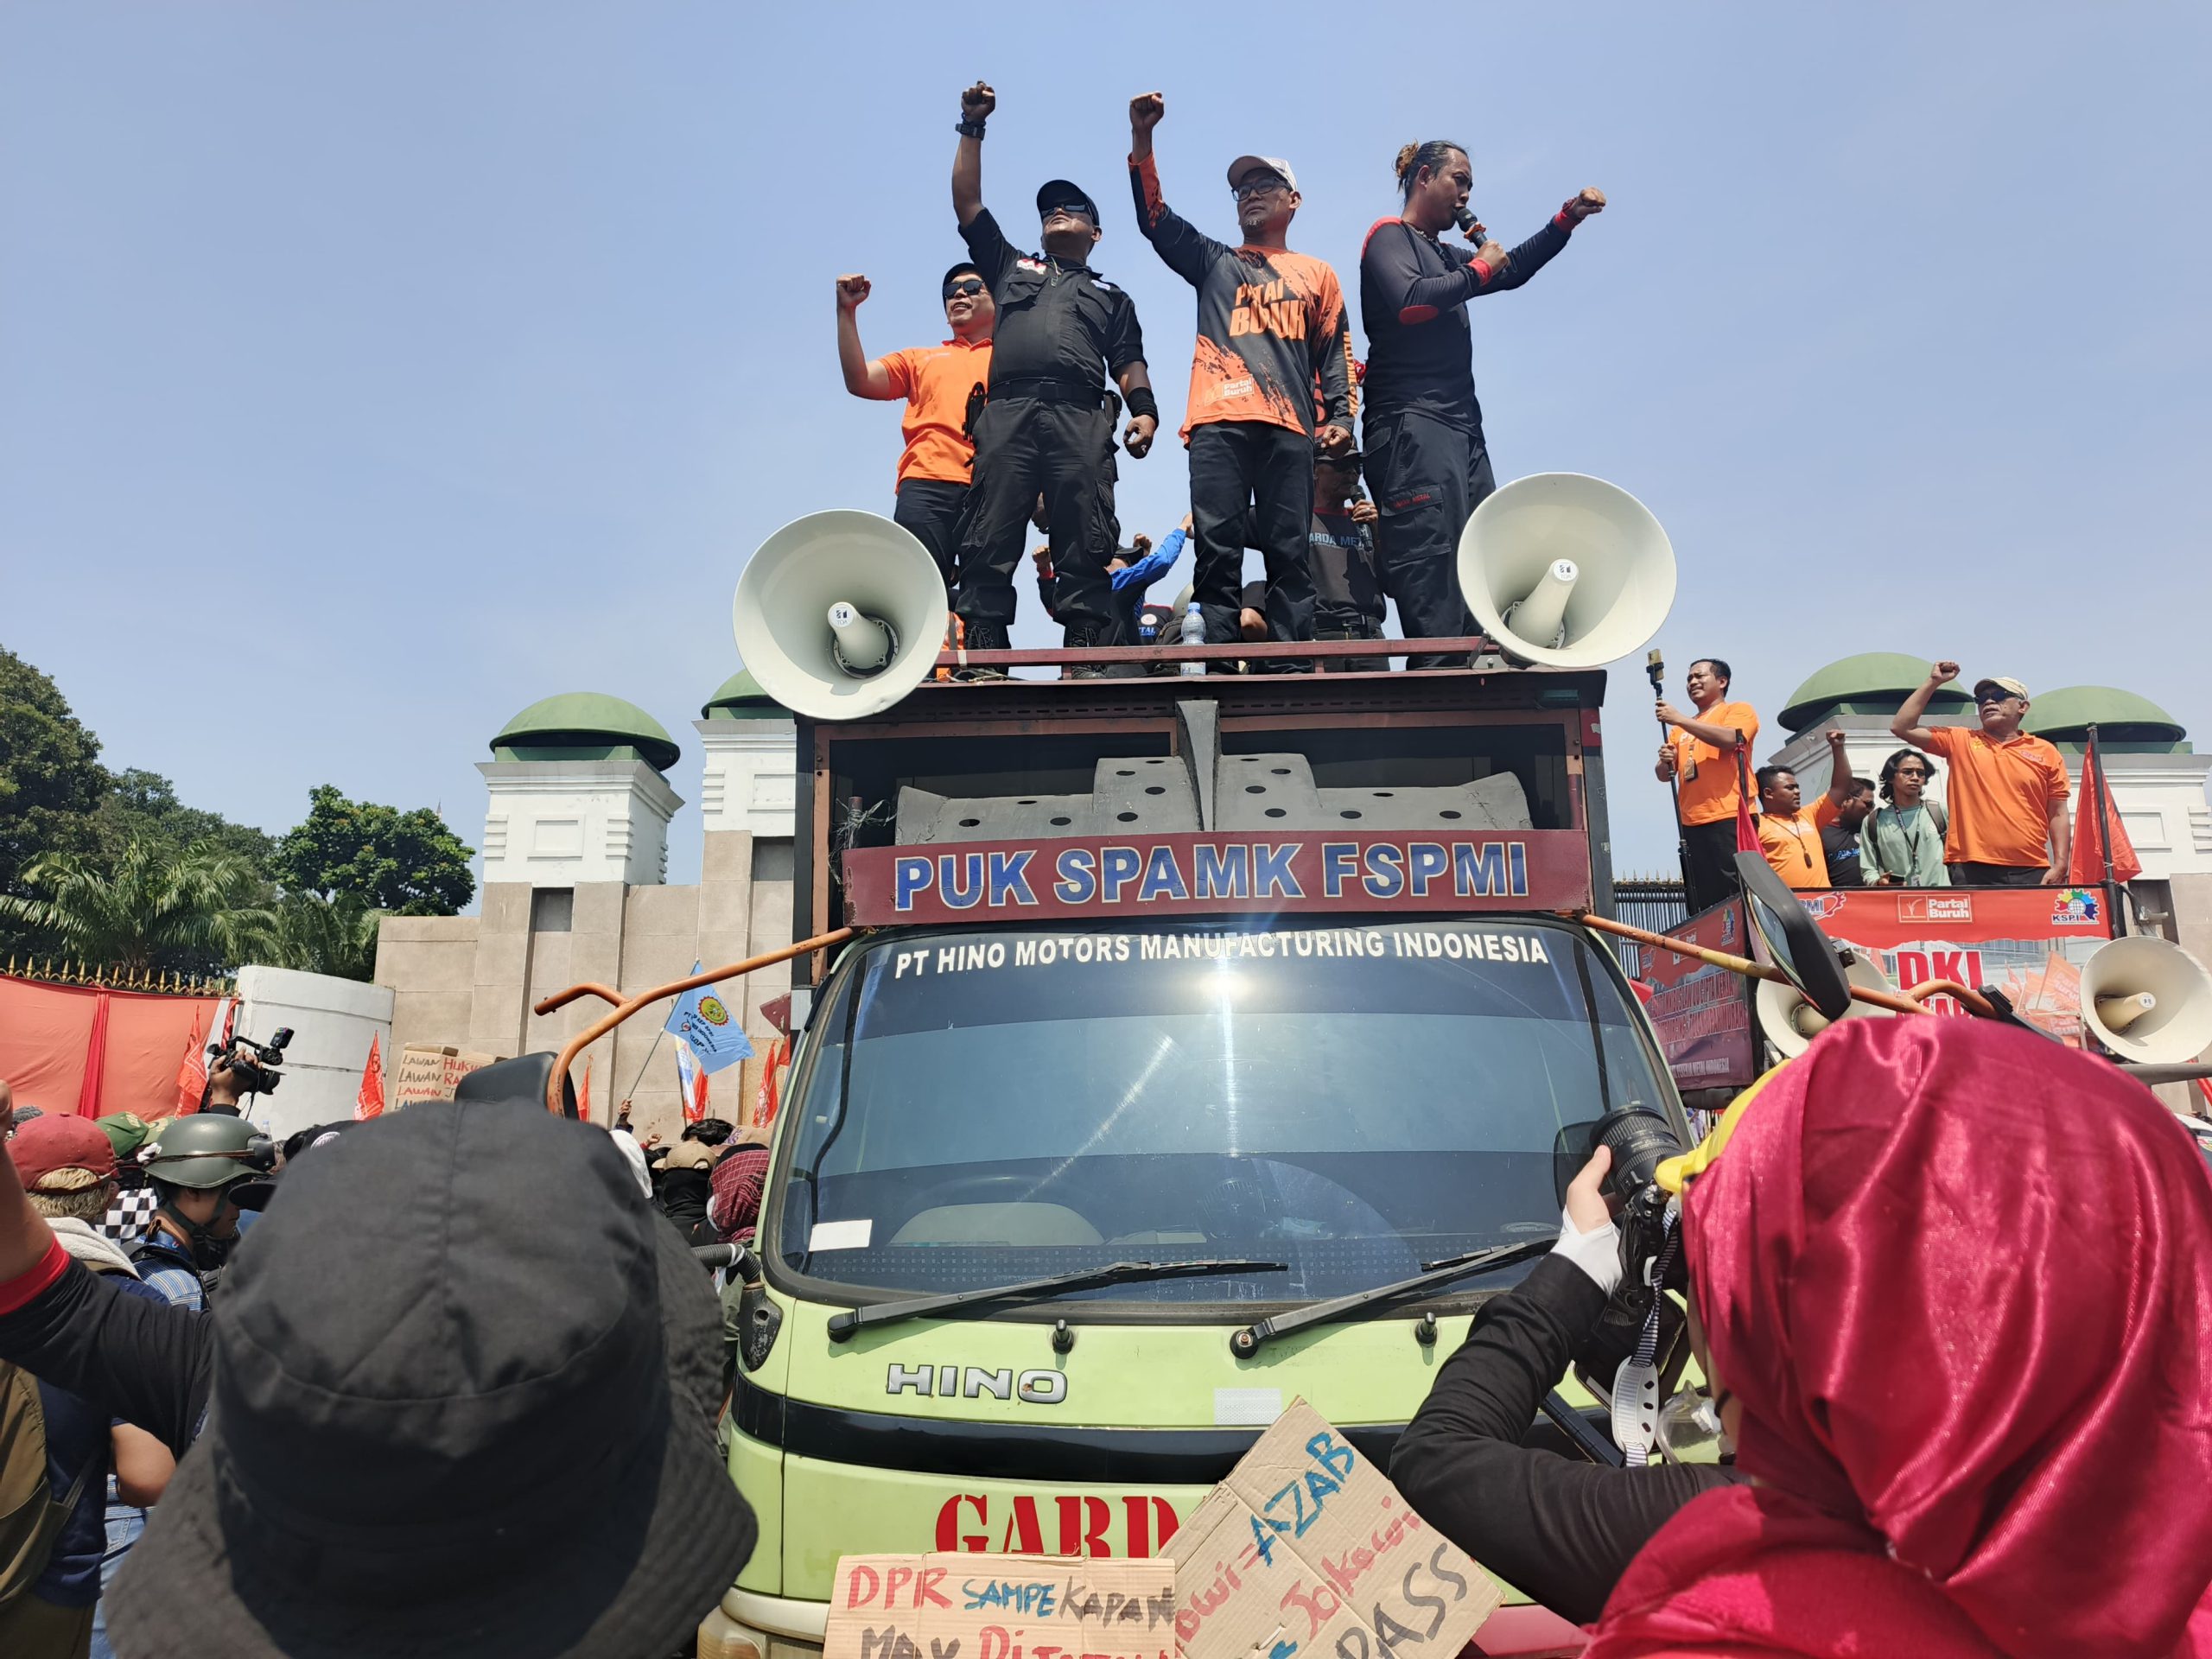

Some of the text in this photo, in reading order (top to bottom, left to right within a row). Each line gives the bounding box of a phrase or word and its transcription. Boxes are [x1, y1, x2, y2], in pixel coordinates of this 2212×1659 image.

[894, 841, 1530, 912] PUK SPAMK FSPMI
[1929, 899, 1968, 908] Partai
[1929, 908, 1969, 918] Buruh
[895, 931, 1549, 978] PT HINO MOTORS MANUFACTURING INDONESIA
[1897, 951, 1984, 991] DKI
[398, 1068, 442, 1083] LAWAN
[403, 1054, 441, 1067] LAWAN
[397, 1086, 442, 1097] LAWAN
[886, 1363, 1068, 1404] HINO
[1250, 1431, 1355, 1567] AZAB
[847, 1565, 953, 1611] DPR
[961, 1578, 1057, 1618] SAMPE
